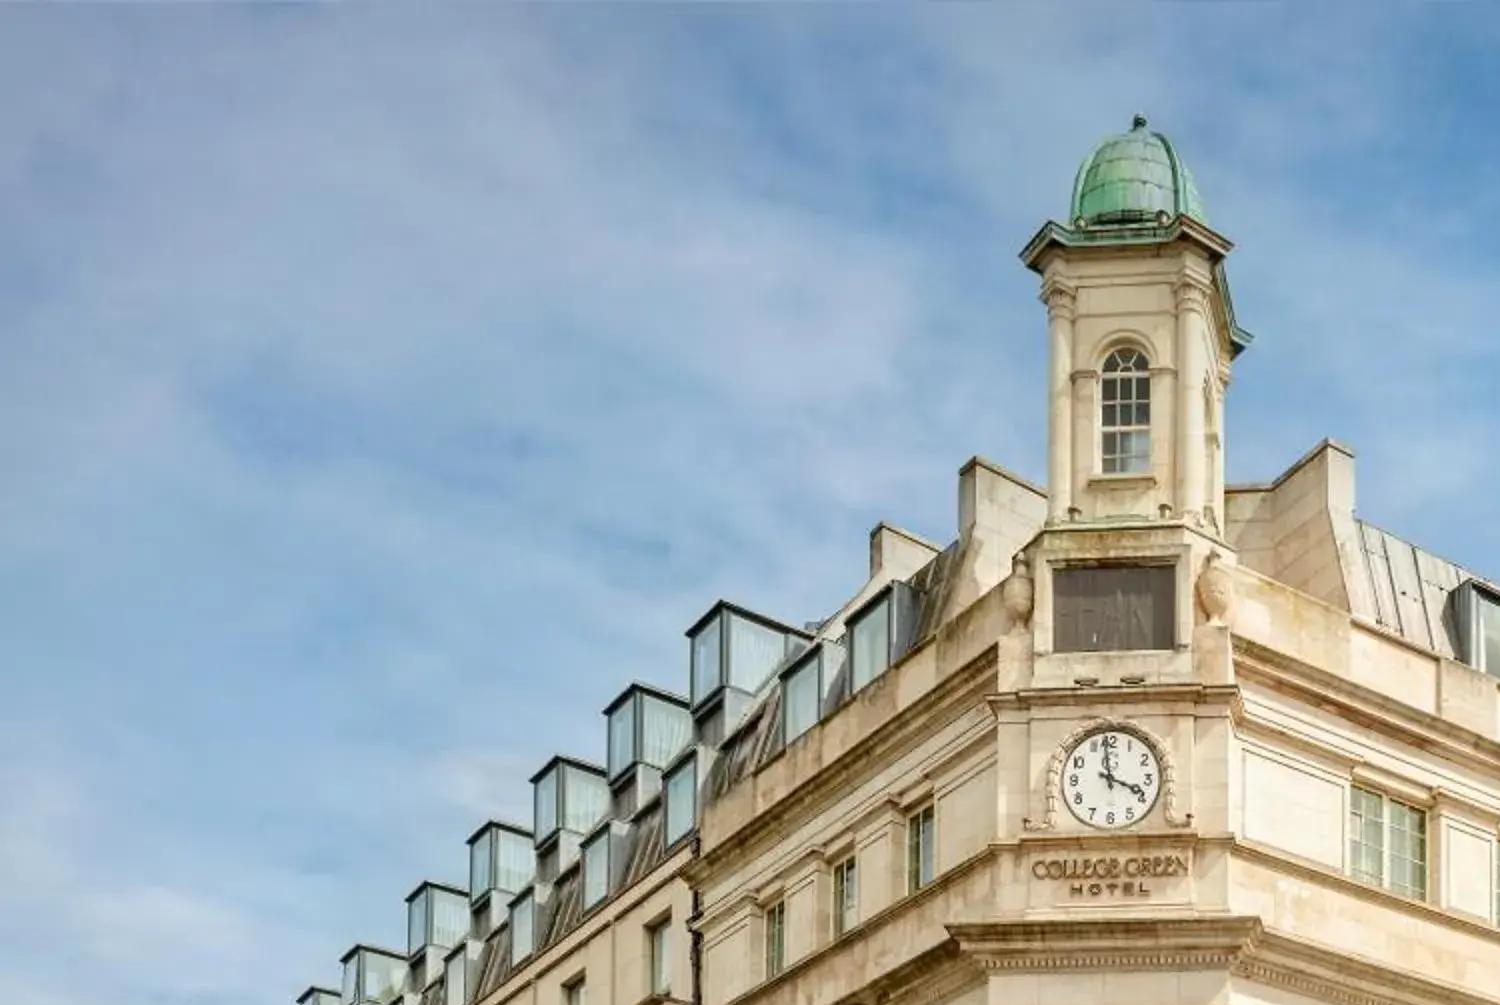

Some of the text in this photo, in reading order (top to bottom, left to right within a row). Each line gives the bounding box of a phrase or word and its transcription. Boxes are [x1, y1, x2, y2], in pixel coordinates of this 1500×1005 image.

[1073, 756, 1085, 768] 10
[1140, 753, 1149, 766] 2
[1069, 774, 1079, 787] 9
[1143, 773, 1152, 786] 3
[1073, 791, 1083, 804] 8
[1088, 807, 1096, 820] 7
[1105, 811, 1115, 824] 6
[1125, 807, 1135, 820] 5
[1032, 855, 1189, 880] COLLEGE GREEN
[1071, 881, 1149, 896] HOTEL
